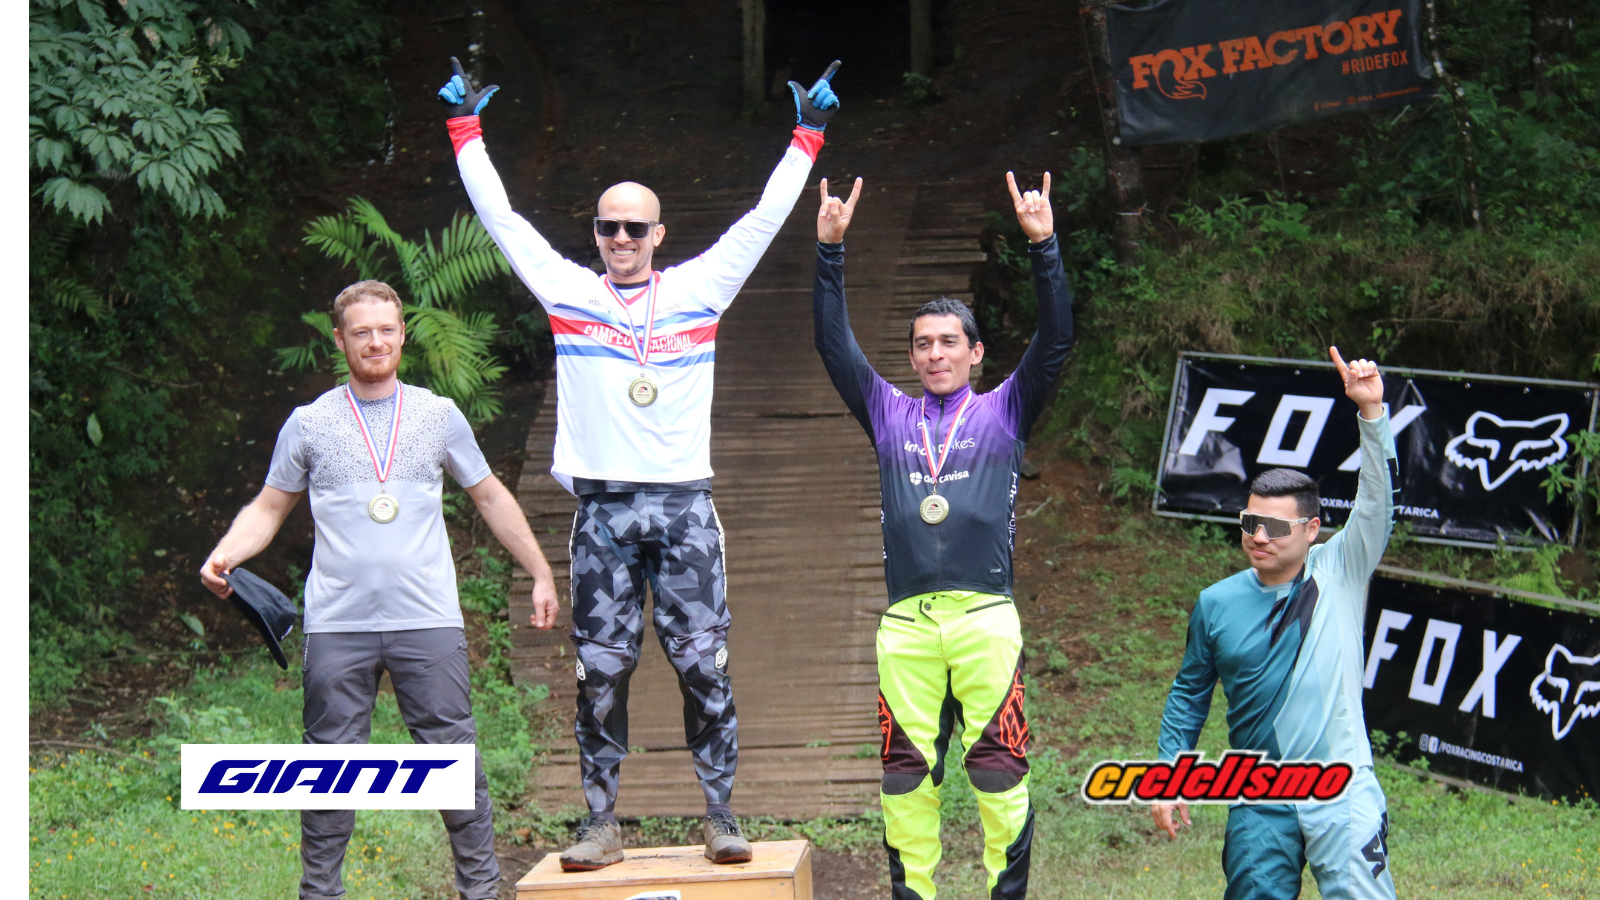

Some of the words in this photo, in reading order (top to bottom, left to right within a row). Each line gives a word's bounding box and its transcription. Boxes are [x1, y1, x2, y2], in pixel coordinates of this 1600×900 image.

[1129, 44, 1216, 93] FOX
[1218, 9, 1402, 74] FACTORY
[1342, 50, 1408, 75] #RIDEFOX
[583, 325, 631, 346] CAMPEO
[649, 333, 697, 351] ACIONAL
[1362, 608, 1522, 719] FOX
